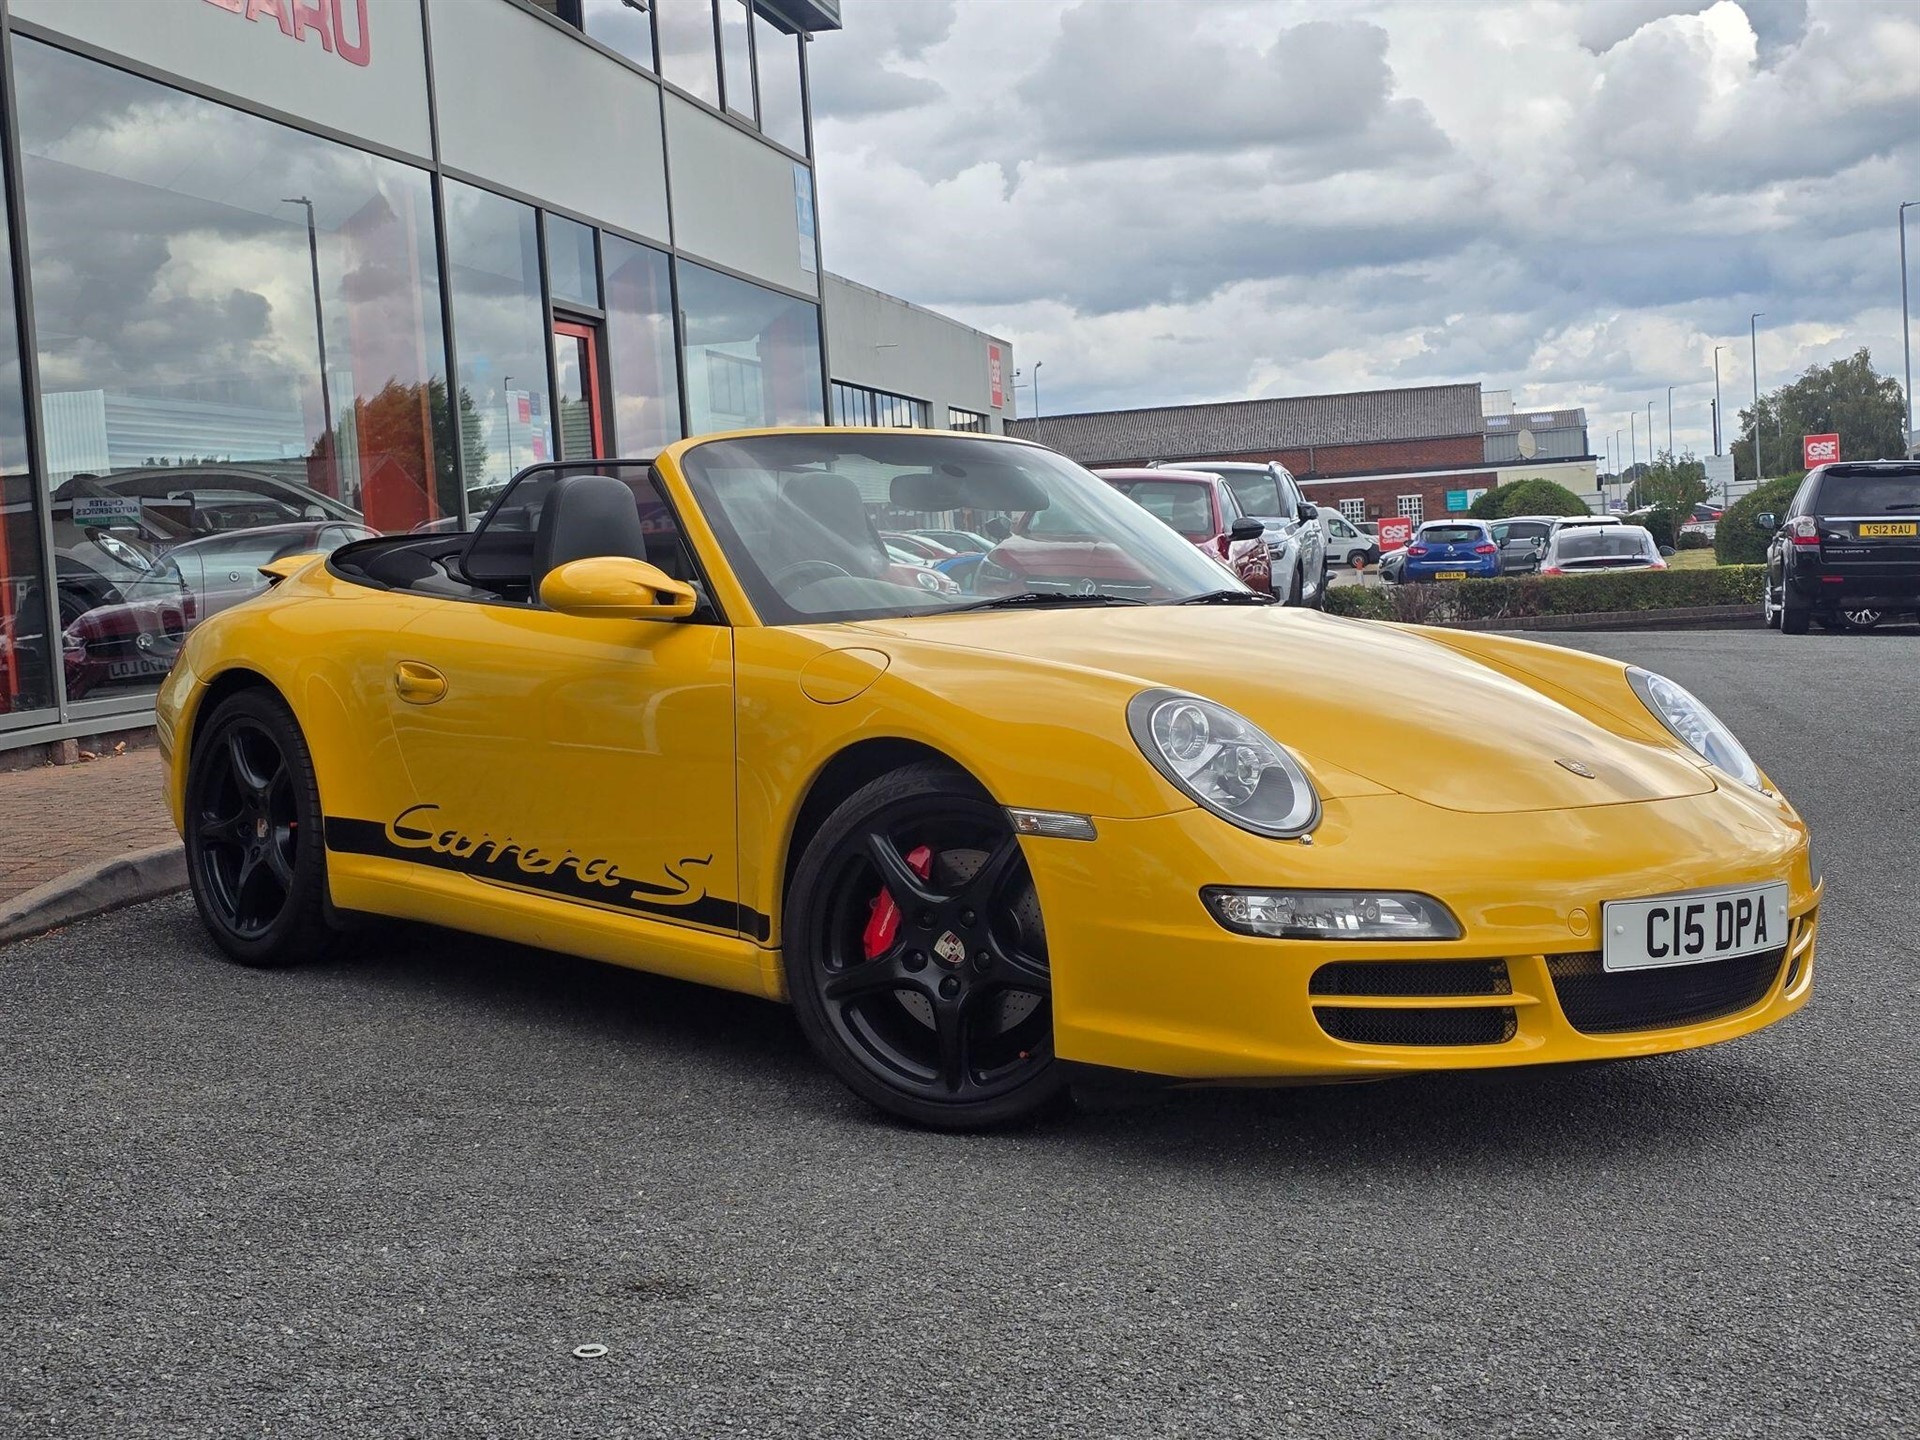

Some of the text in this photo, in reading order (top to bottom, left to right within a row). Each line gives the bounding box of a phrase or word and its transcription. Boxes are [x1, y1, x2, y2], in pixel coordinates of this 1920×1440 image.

[204, 0, 370, 66] ARU
[1807, 441, 1836, 455] GSF
[1381, 525, 1409, 538] GSF
[1865, 525, 1911, 534] YS12 RAU
[385, 804, 713, 905] Carrera S
[1646, 895, 1768, 958] C15 DPA
